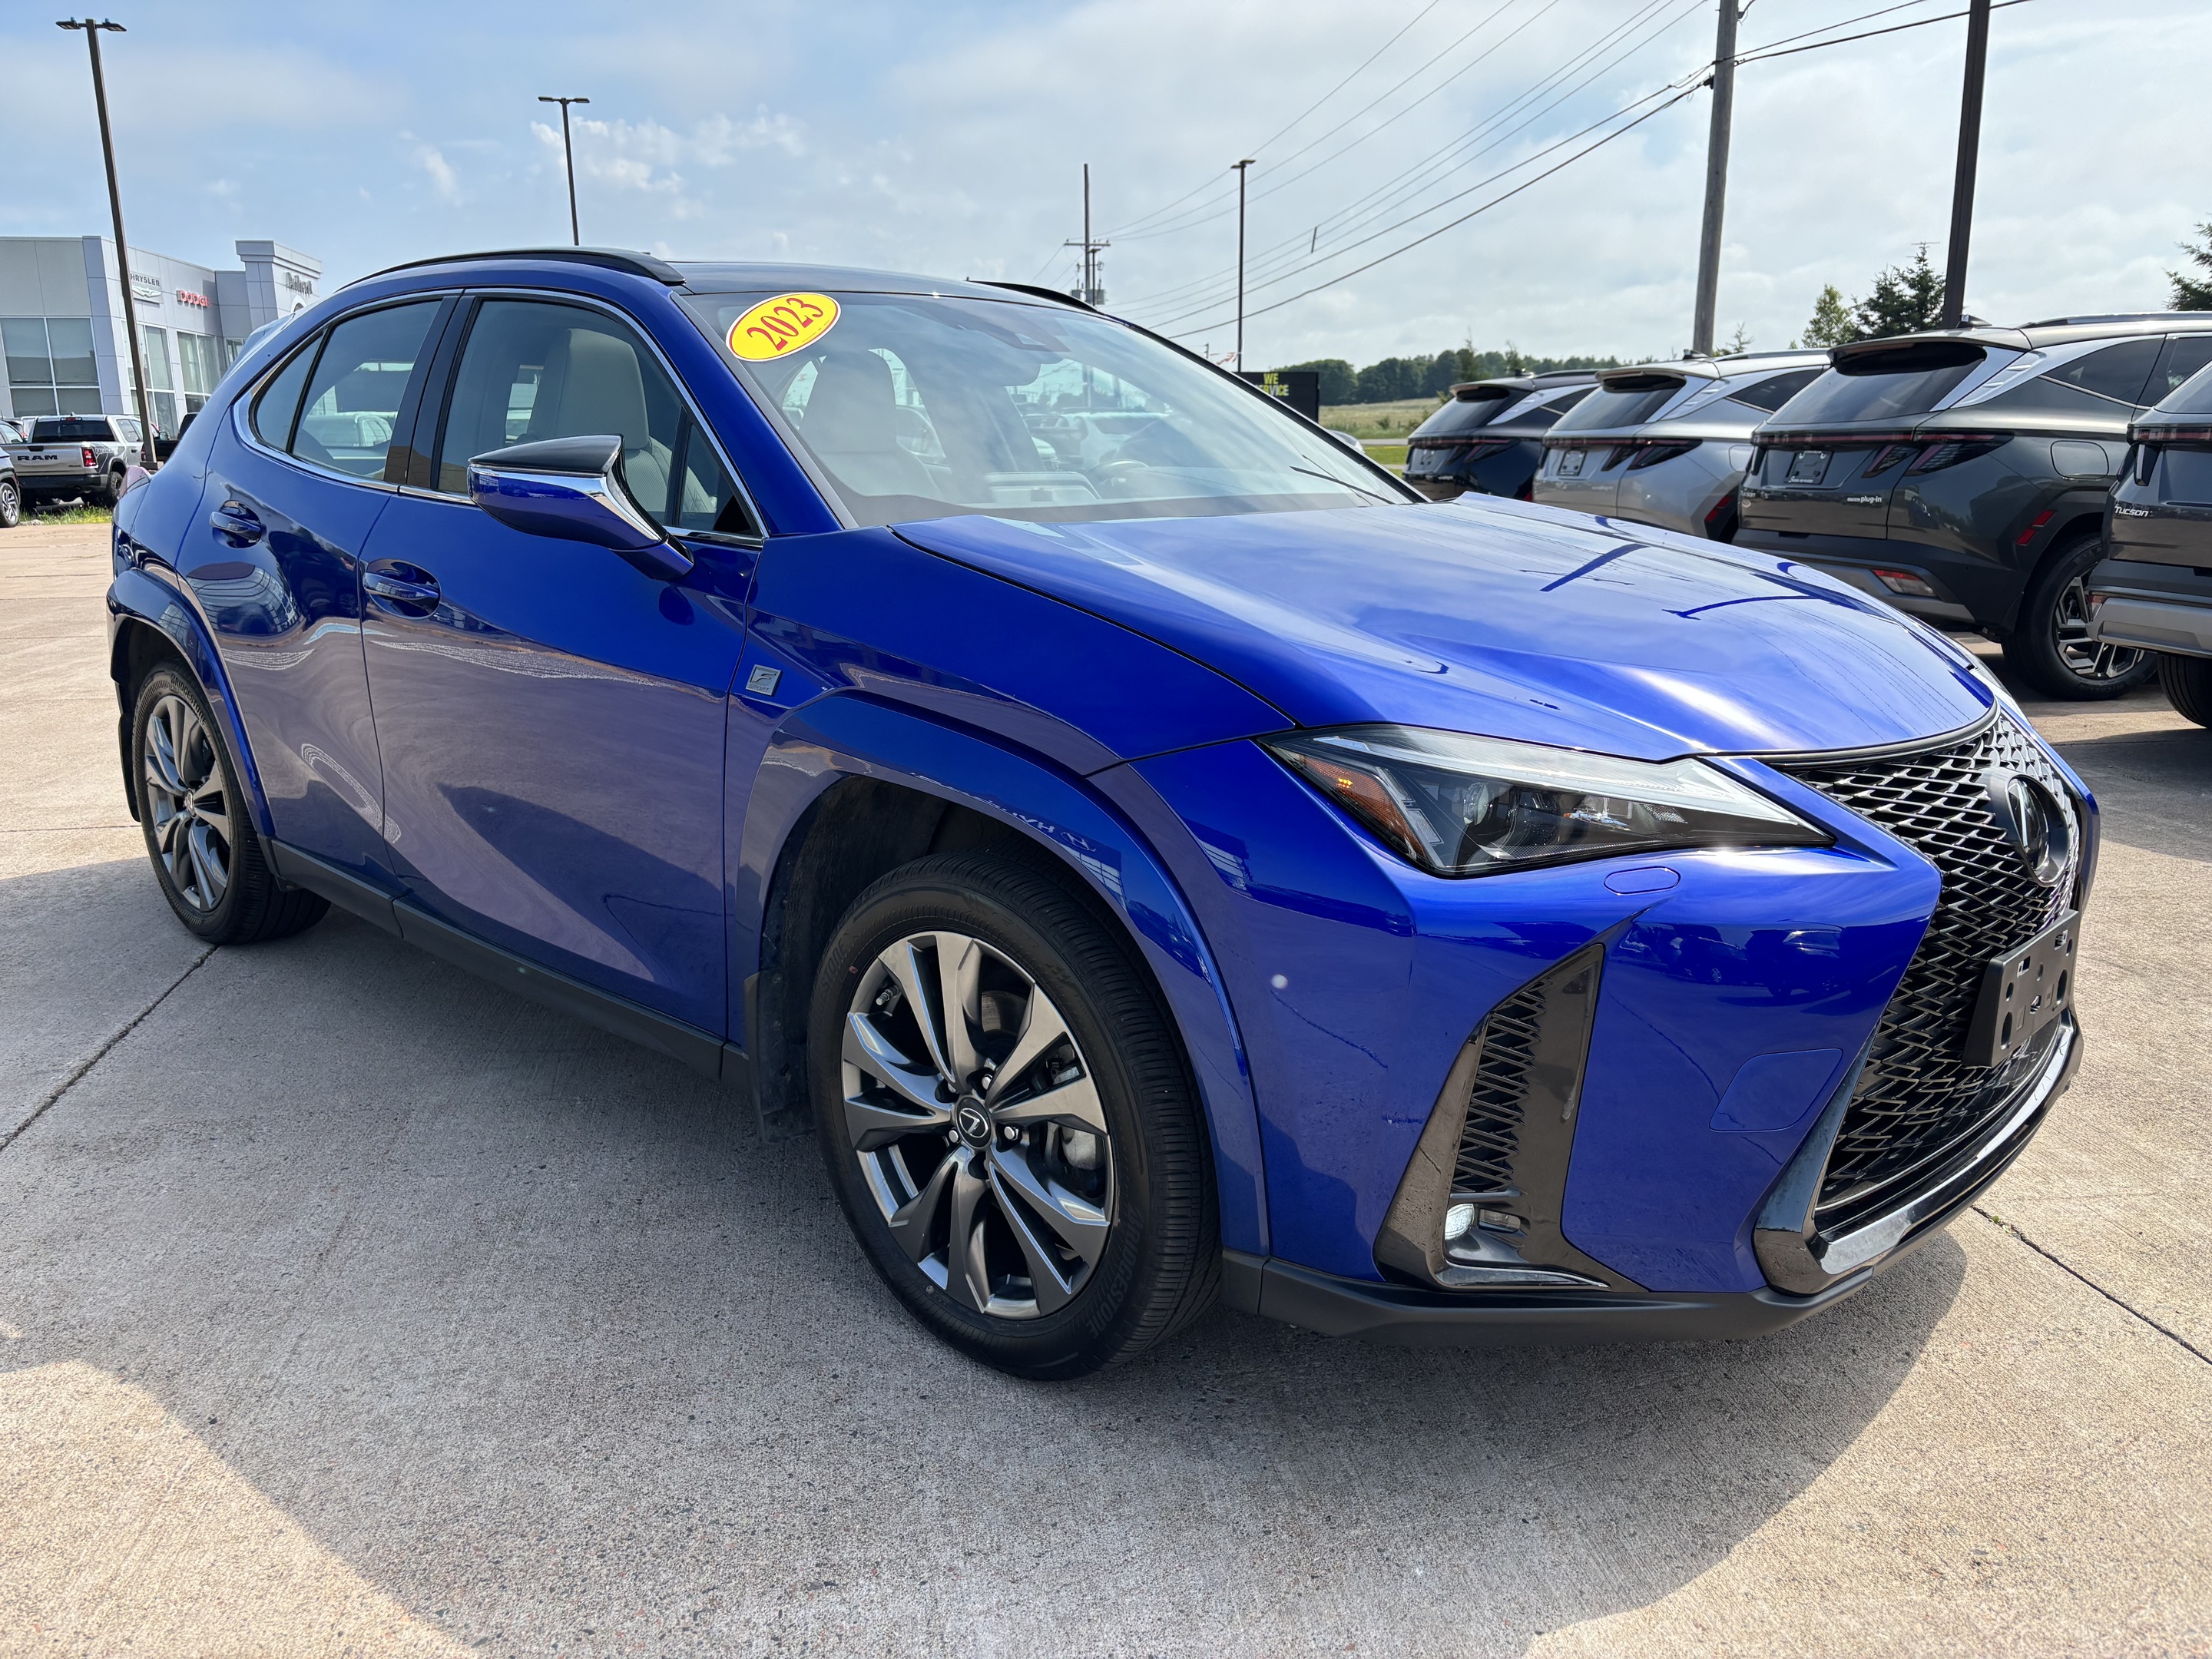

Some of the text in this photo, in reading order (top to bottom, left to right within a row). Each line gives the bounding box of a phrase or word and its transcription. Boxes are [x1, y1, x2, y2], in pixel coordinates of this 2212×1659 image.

[130, 273, 161, 287] HRYSLER
[747, 297, 824, 352] 2023
[1263, 373, 1280, 385] WE
[1257, 384, 1290, 397] RVICE
[2114, 505, 2149, 517] Tucson
[748, 684, 770, 693] SPORT
[1086, 1200, 1145, 1339] BRIDGESTONE
